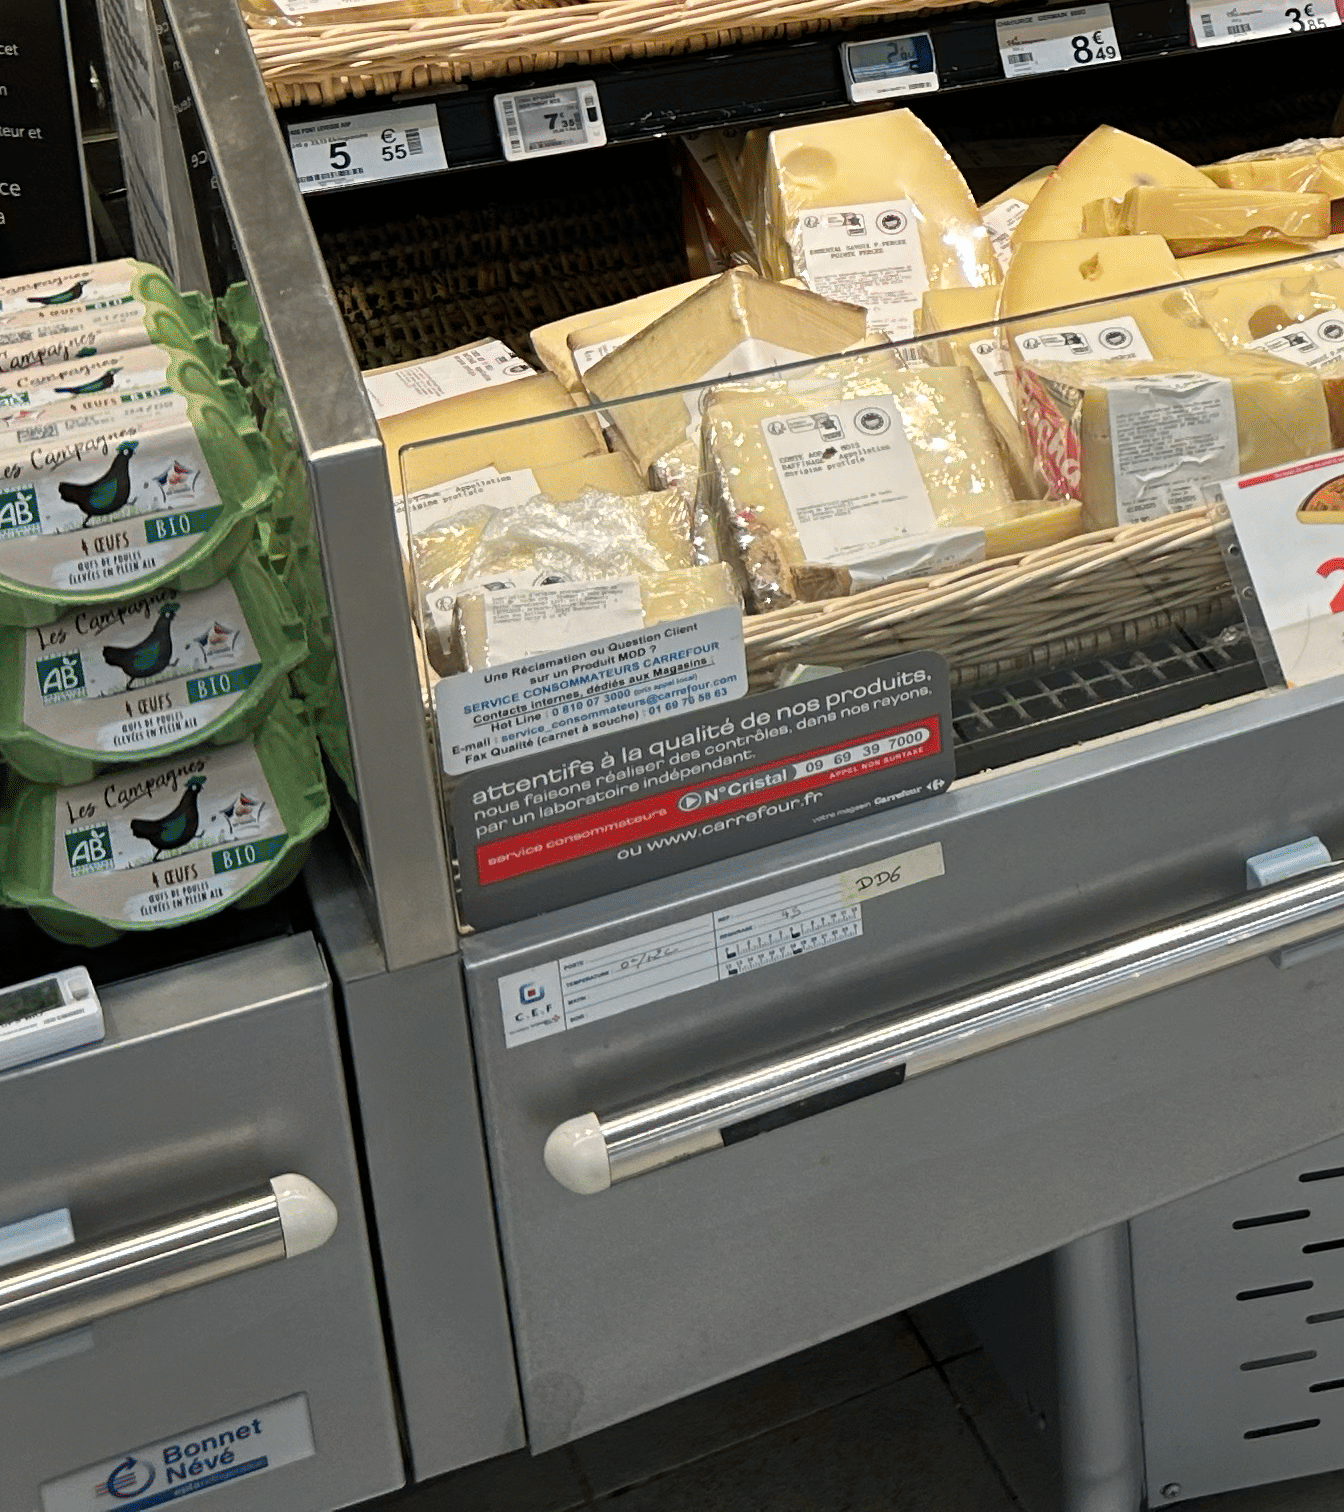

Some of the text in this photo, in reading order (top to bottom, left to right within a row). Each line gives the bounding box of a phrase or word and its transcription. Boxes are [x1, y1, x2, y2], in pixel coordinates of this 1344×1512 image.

[329, 141, 352, 170] 5
[381, 143, 408, 163] 55
[30, 427, 138, 472] Campagnes
[94, 531, 130, 554] ŒUFS
[155, 513, 191, 539] BIO
[36, 623, 66, 651] Les
[483, 622, 699, 686] Une Réclamation ou Question Client
[43, 665, 79, 695] AB
[463, 639, 721, 716] SERVICE CONSOMMATEURS CARREFOUR
[530, 648, 646, 686] sur un Produit MOD
[138, 692, 173, 713] ŒUFS
[196, 673, 231, 700] BIO
[473, 658, 708, 725] Contacts dédiés aux Magasins
[452, 672, 738, 757] E-mail service_consommateurs@carrefour.com
[490, 688, 631, 734] Hot Line 810 3000
[465, 710, 641, 766] Fax Qualité (carnet souche)
[471, 666, 934, 808] attentifs à la qualité de nos produits.
[472, 686, 934, 822] nous faisons réaliser des contrôles, dans nos rayons,
[829, 757, 882, 780] APPEL NON
[66, 757, 207, 824] Les Campagnes
[475, 747, 757, 841] par un laboratoire indépendant.
[487, 729, 925, 867] service consommateurs 09 69 39 7000
[873, 784, 924, 807] Carrefour
[616, 790, 824, 863] ou www.carrefour.fr
[71, 836, 108, 867] AB
[221, 844, 257, 871] BIO
[164, 863, 199, 885] ŒUFS
[162, 1417, 263, 1466] Bonnet
[164, 1448, 236, 1485] Névé
